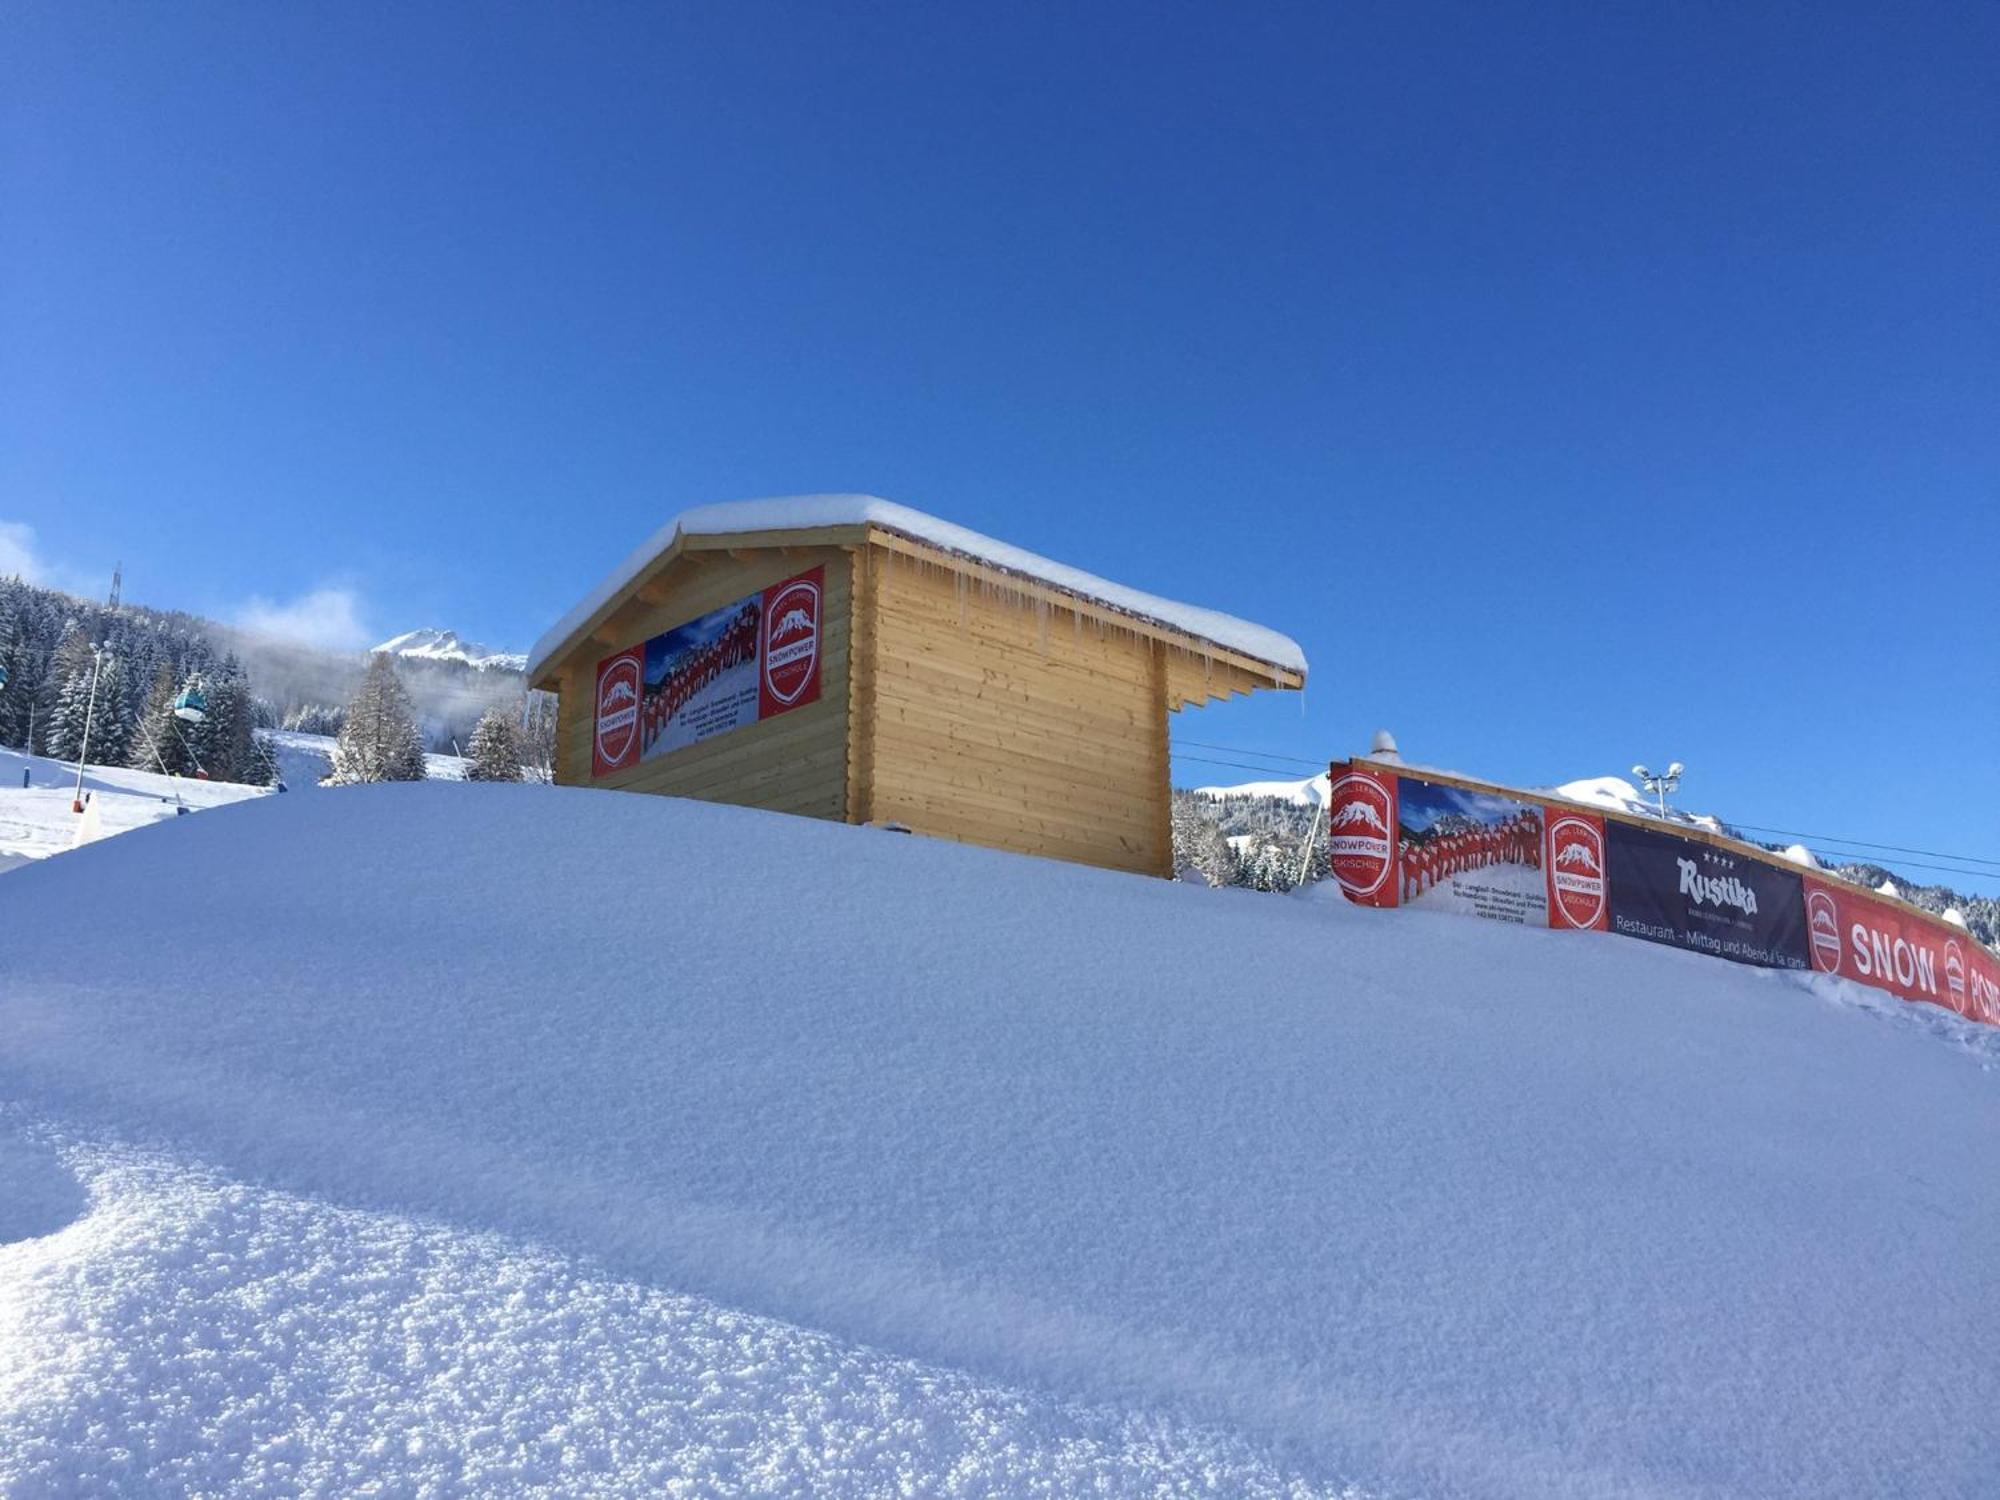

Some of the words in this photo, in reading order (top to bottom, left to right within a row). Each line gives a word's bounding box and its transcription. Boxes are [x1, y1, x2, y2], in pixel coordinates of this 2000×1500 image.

[769, 640, 815, 665] SNOWPOWER
[1556, 874, 1601, 891] SNOWPOWER
[1677, 856, 1758, 916] Rustika
[1616, 915, 1675, 940] Restaurant
[1686, 930, 1721, 953] Mittag
[1723, 940, 1740, 955] und
[1742, 943, 1769, 962] Abend
[1852, 923, 1937, 995] SNOW
